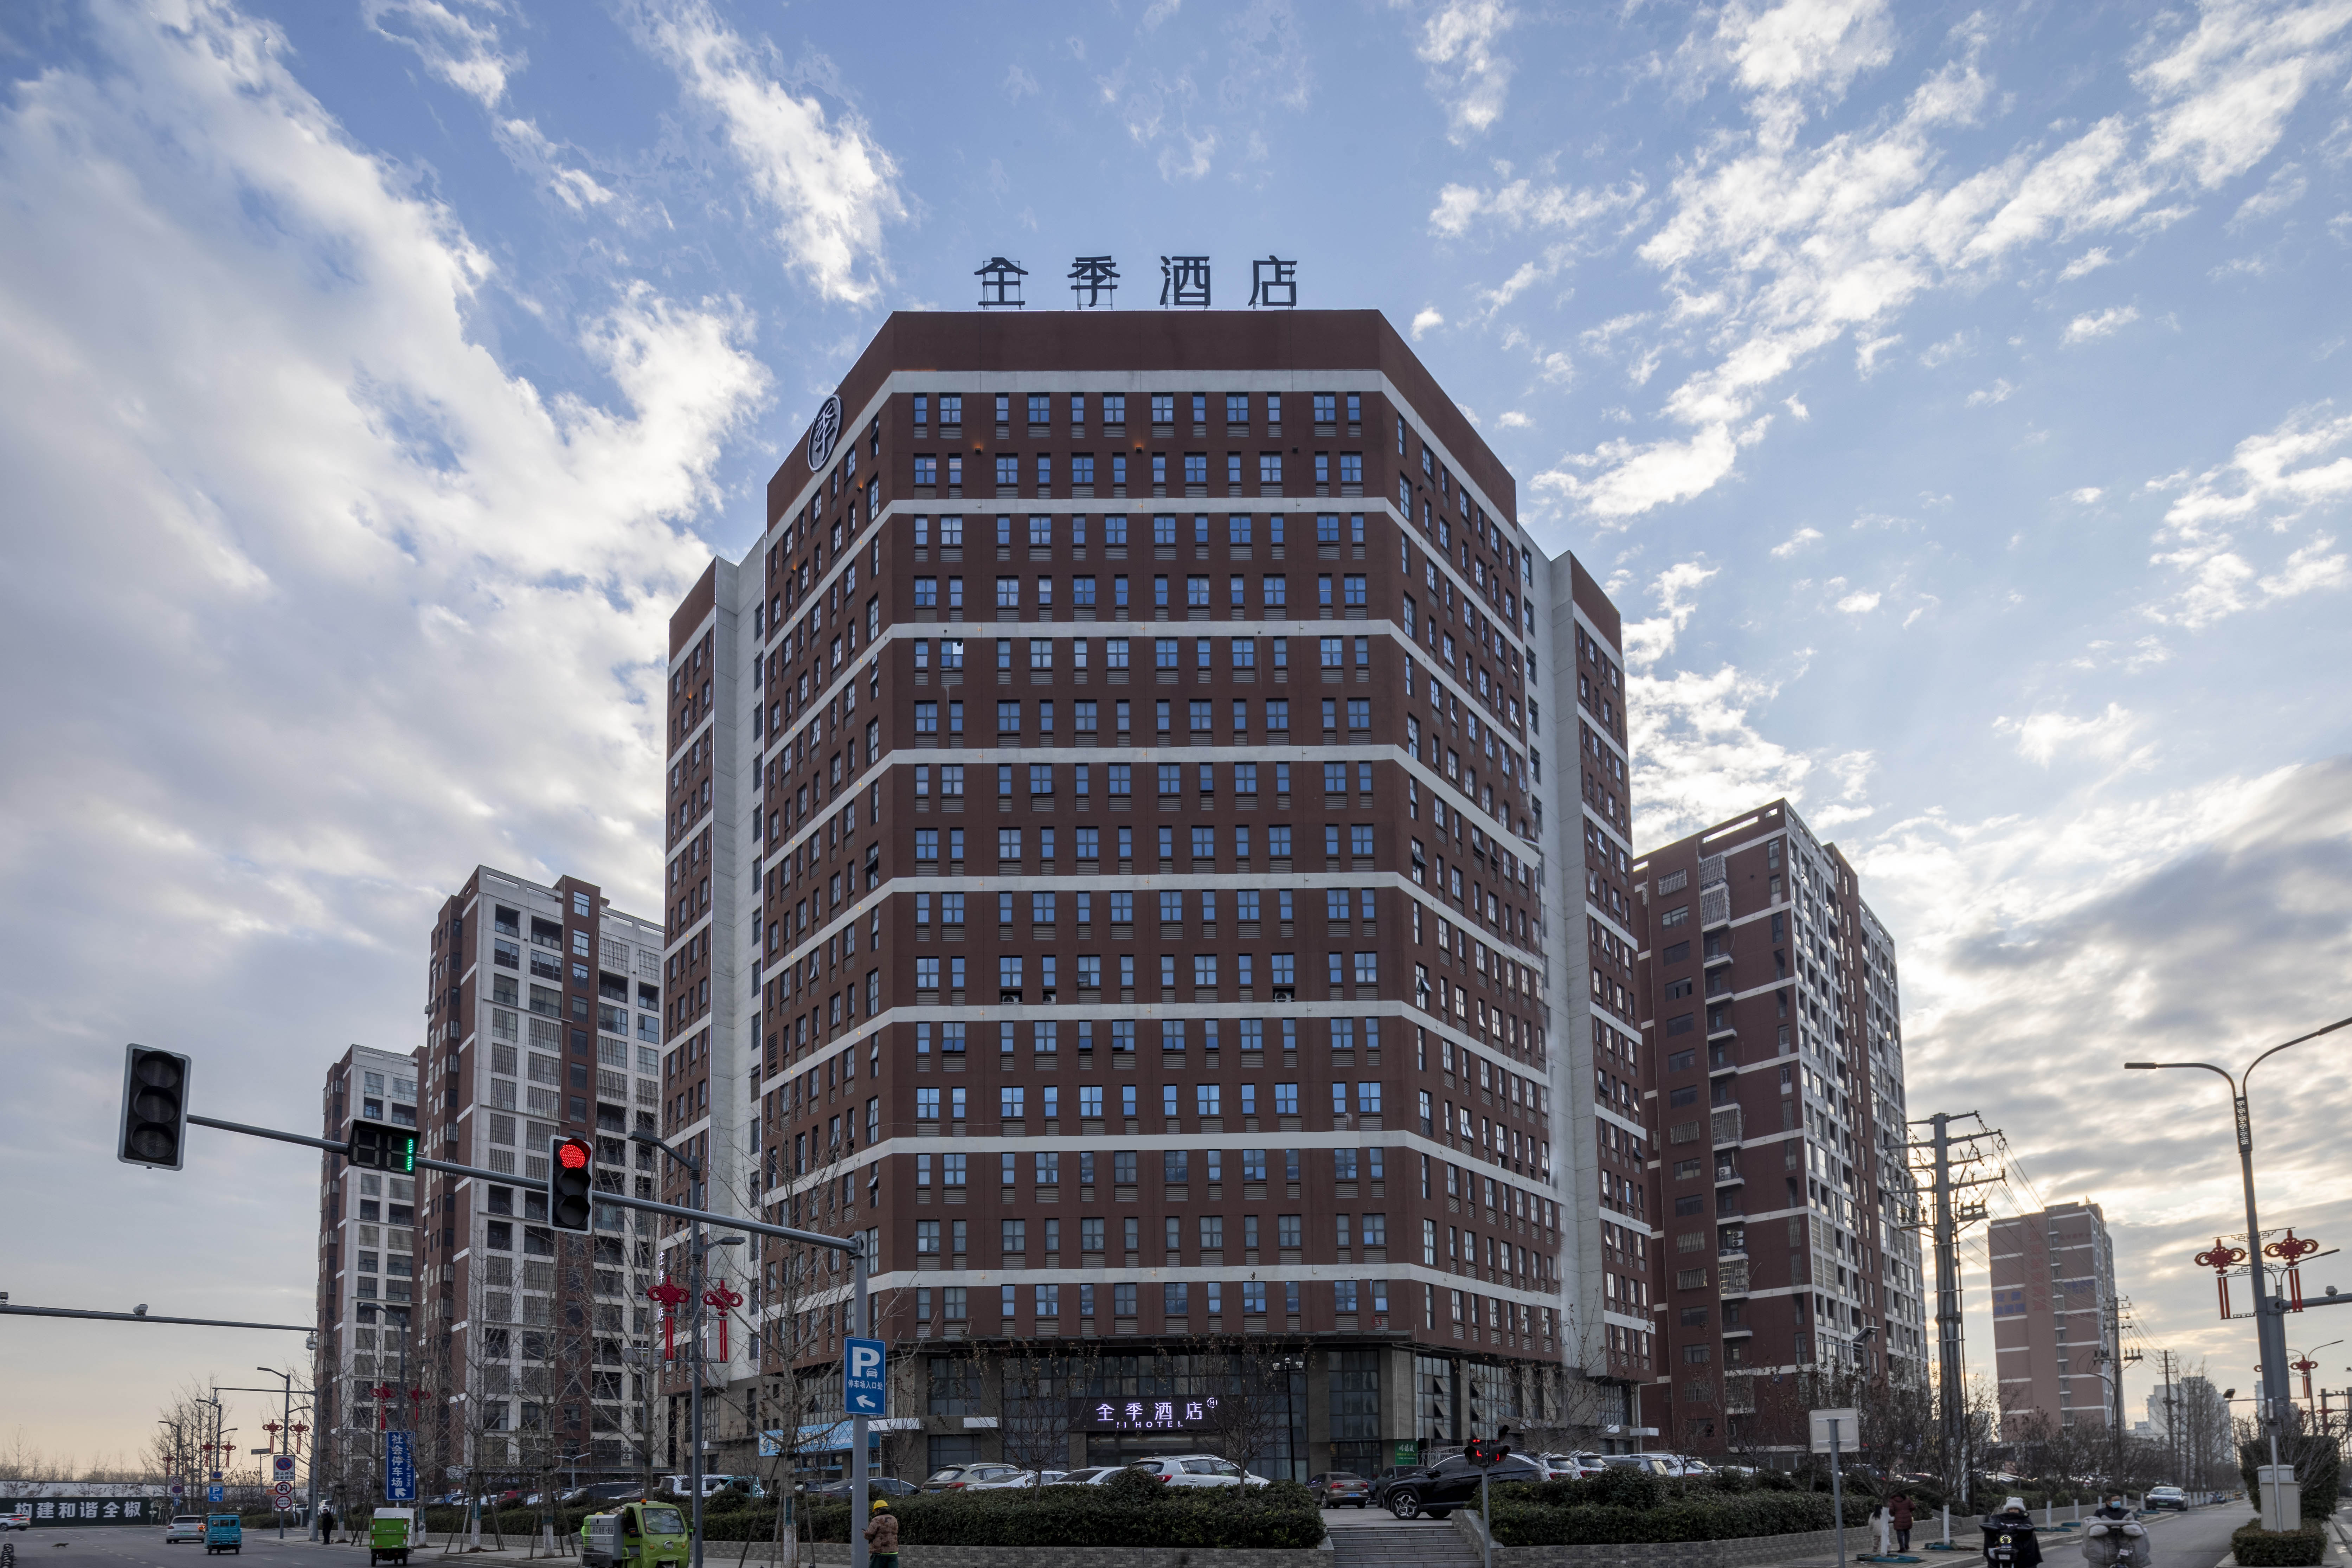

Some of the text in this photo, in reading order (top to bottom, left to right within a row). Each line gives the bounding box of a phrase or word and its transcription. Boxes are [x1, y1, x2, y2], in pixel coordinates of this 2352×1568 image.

[974, 255, 1297, 307] 全季酒店
[852, 1347, 880, 1377] P
[848, 1379, 883, 1390] 停车场入口处
[1096, 1402, 1202, 1421] 全季酒店
[391, 1434, 403, 1487] 社会停车场
[15, 1502, 141, 1518] 构建和谐全椒
